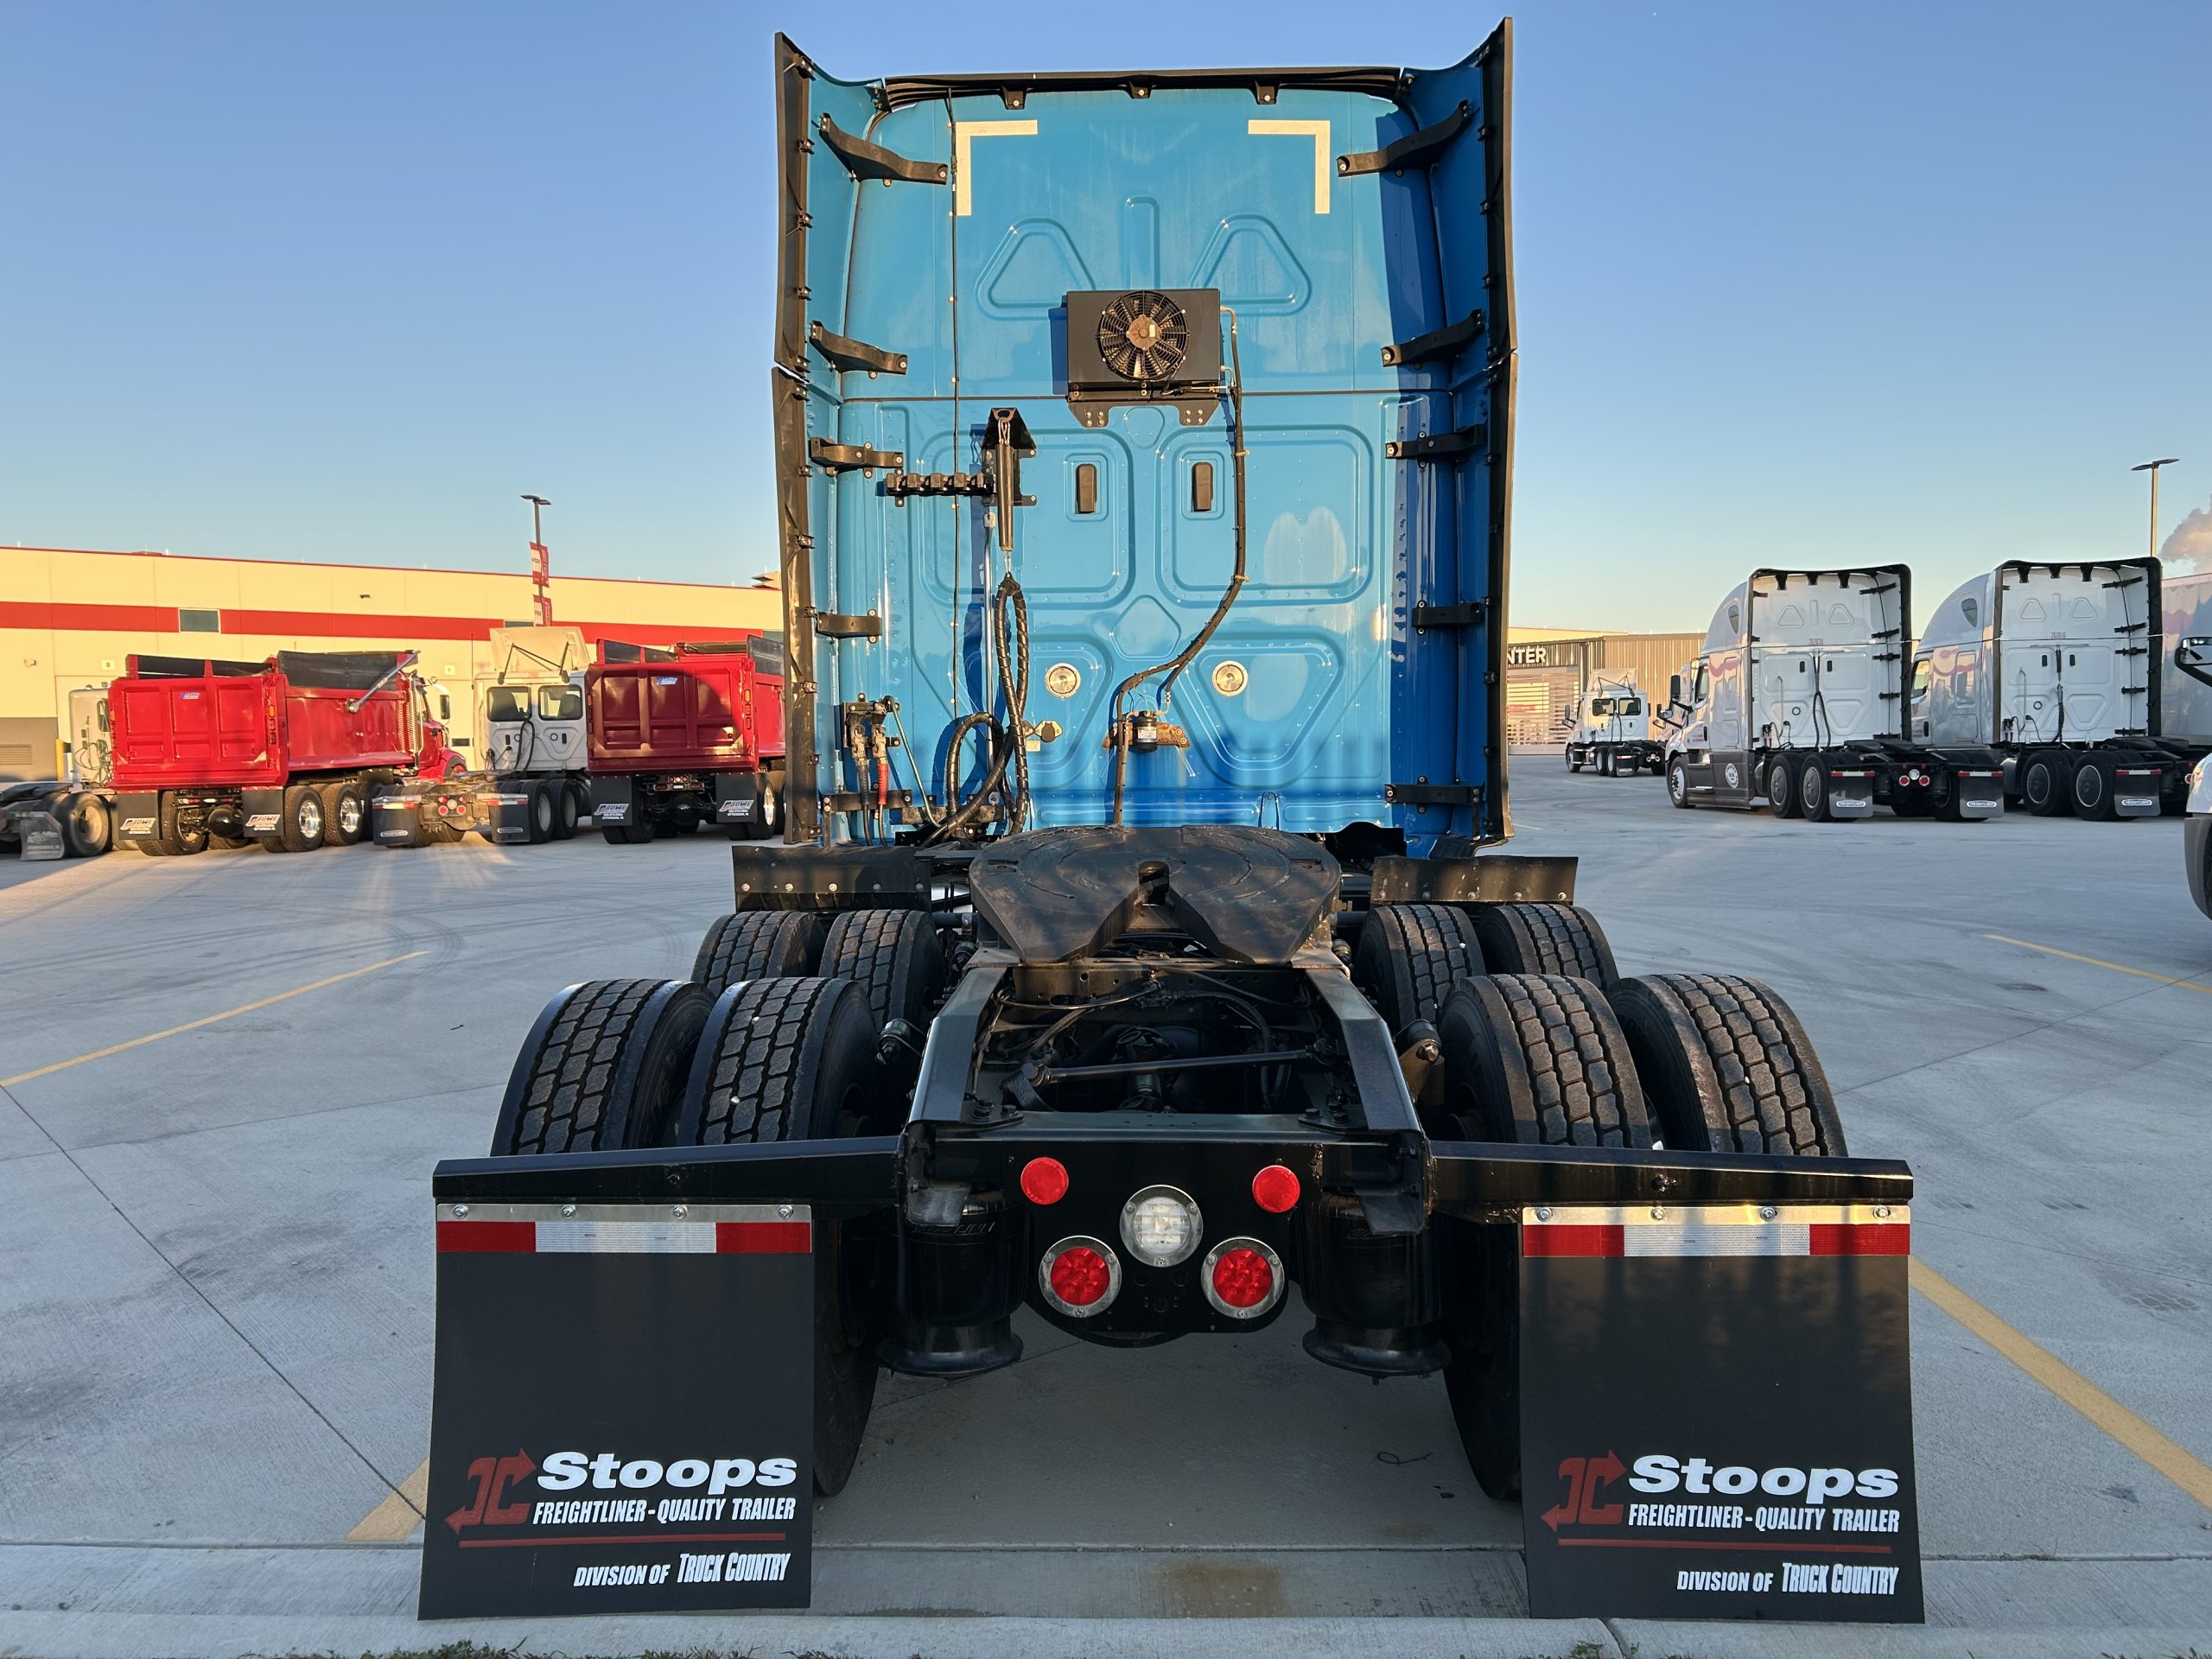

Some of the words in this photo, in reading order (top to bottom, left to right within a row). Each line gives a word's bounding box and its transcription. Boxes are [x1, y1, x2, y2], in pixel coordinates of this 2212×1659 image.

[537, 1452, 797, 1495] Stoops
[1629, 1455, 1898, 1504] Stoops
[732, 1497, 796, 1521] TRAILER
[1833, 1509, 1899, 1533] TRAILER
[574, 1565, 648, 1586] DIVISION
[649, 1565, 671, 1585] OF
[677, 1554, 725, 1583] TRUCK
[725, 1553, 791, 1582] COUNTRY
[1677, 1571, 1750, 1592] DIVISION
[1752, 1573, 1773, 1592] OF
[1783, 1563, 1829, 1592] TRUCK
[1831, 1564, 1899, 1595] COUNTRY
